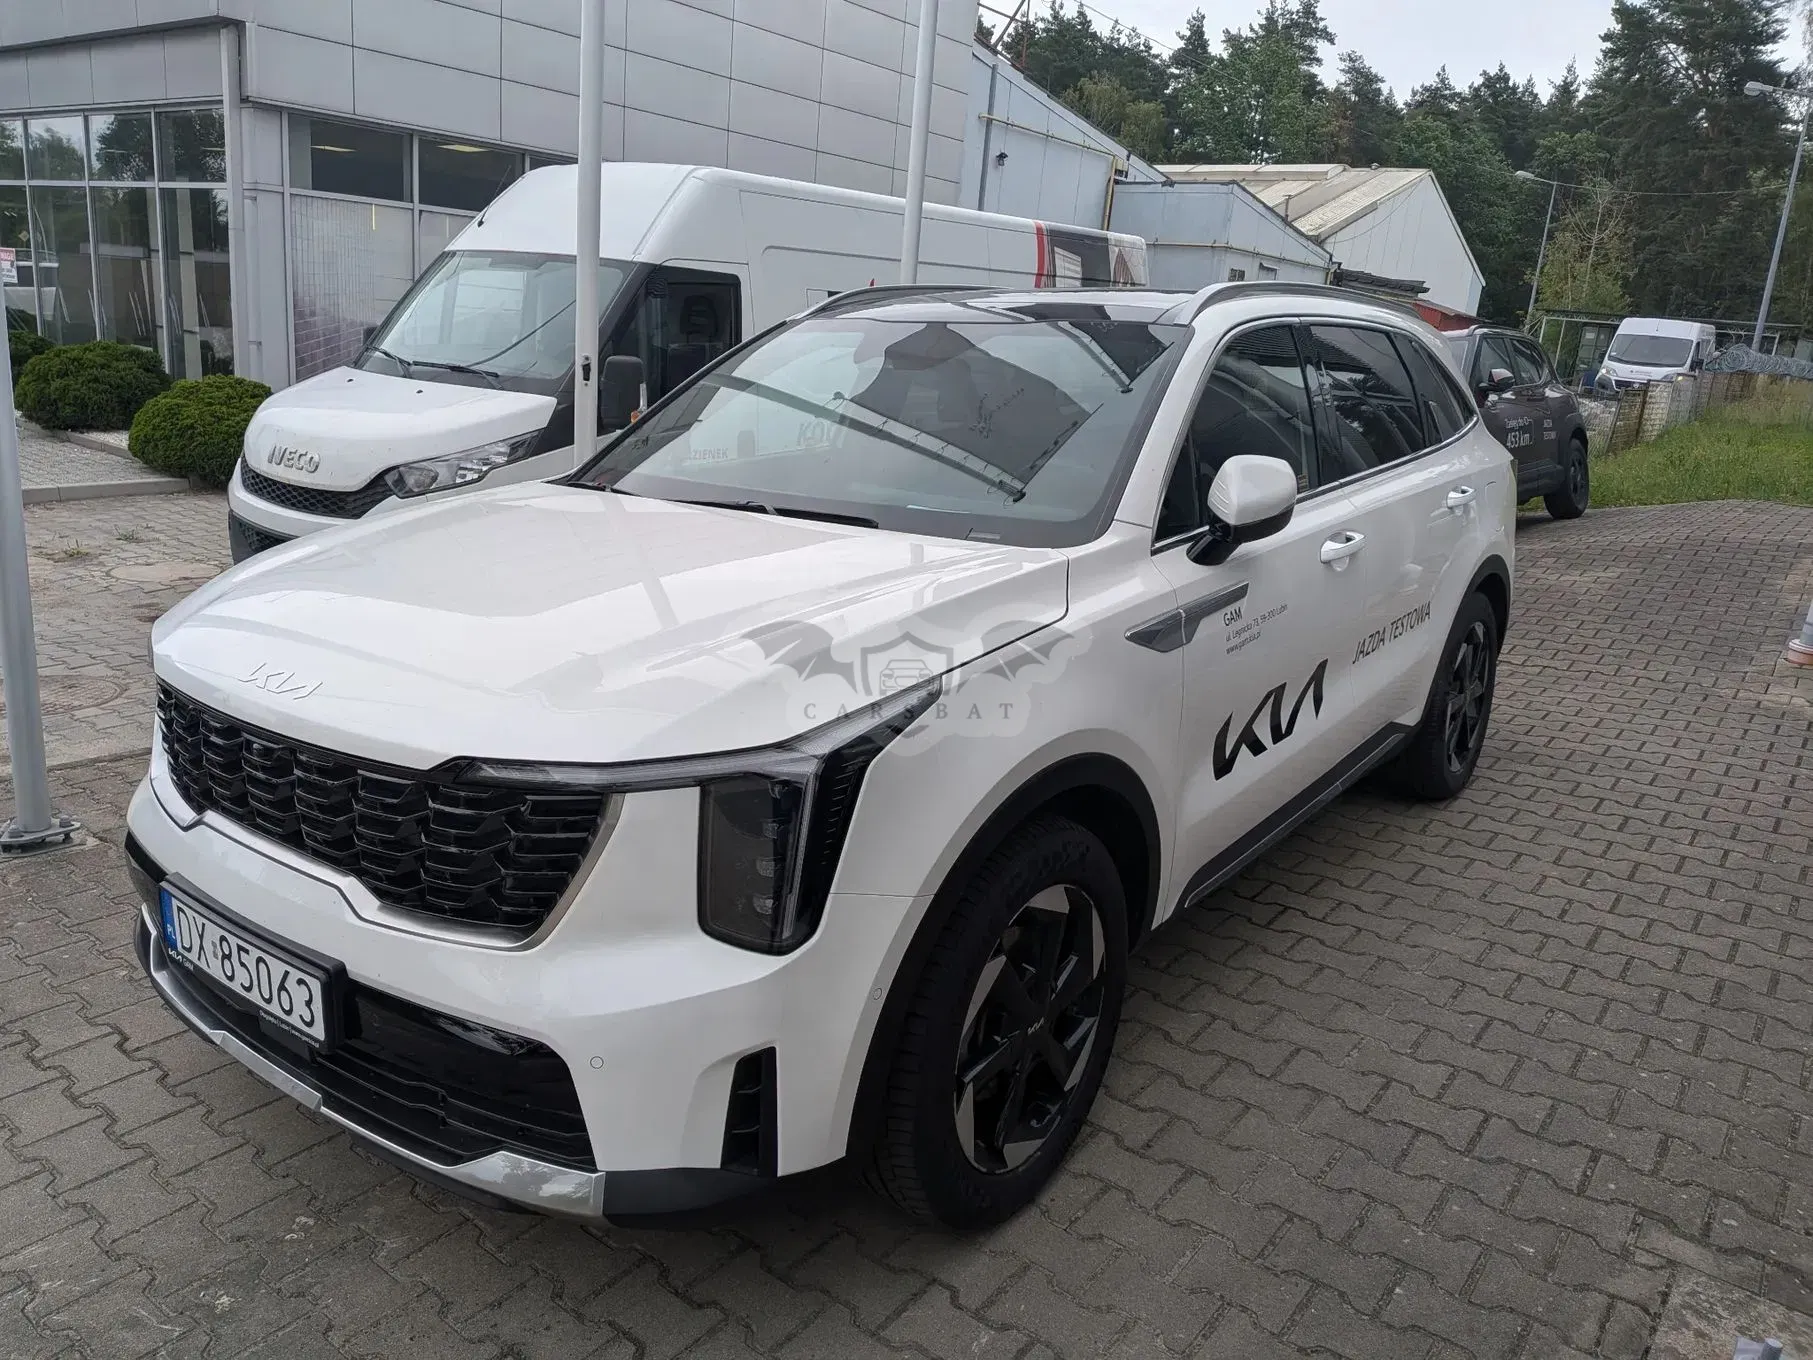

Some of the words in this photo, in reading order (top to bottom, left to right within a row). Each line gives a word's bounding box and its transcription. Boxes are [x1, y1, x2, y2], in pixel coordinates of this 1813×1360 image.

[267, 443, 321, 474] IVECO
[1223, 606, 1243, 627] GAM
[1352, 622, 1386, 665] JAZDA
[1388, 600, 1432, 642] TESTOWA
[1212, 657, 1329, 782] KIA
[167, 923, 176, 939] PL
[176, 904, 211, 970] DX
[218, 934, 315, 1029] 85063
